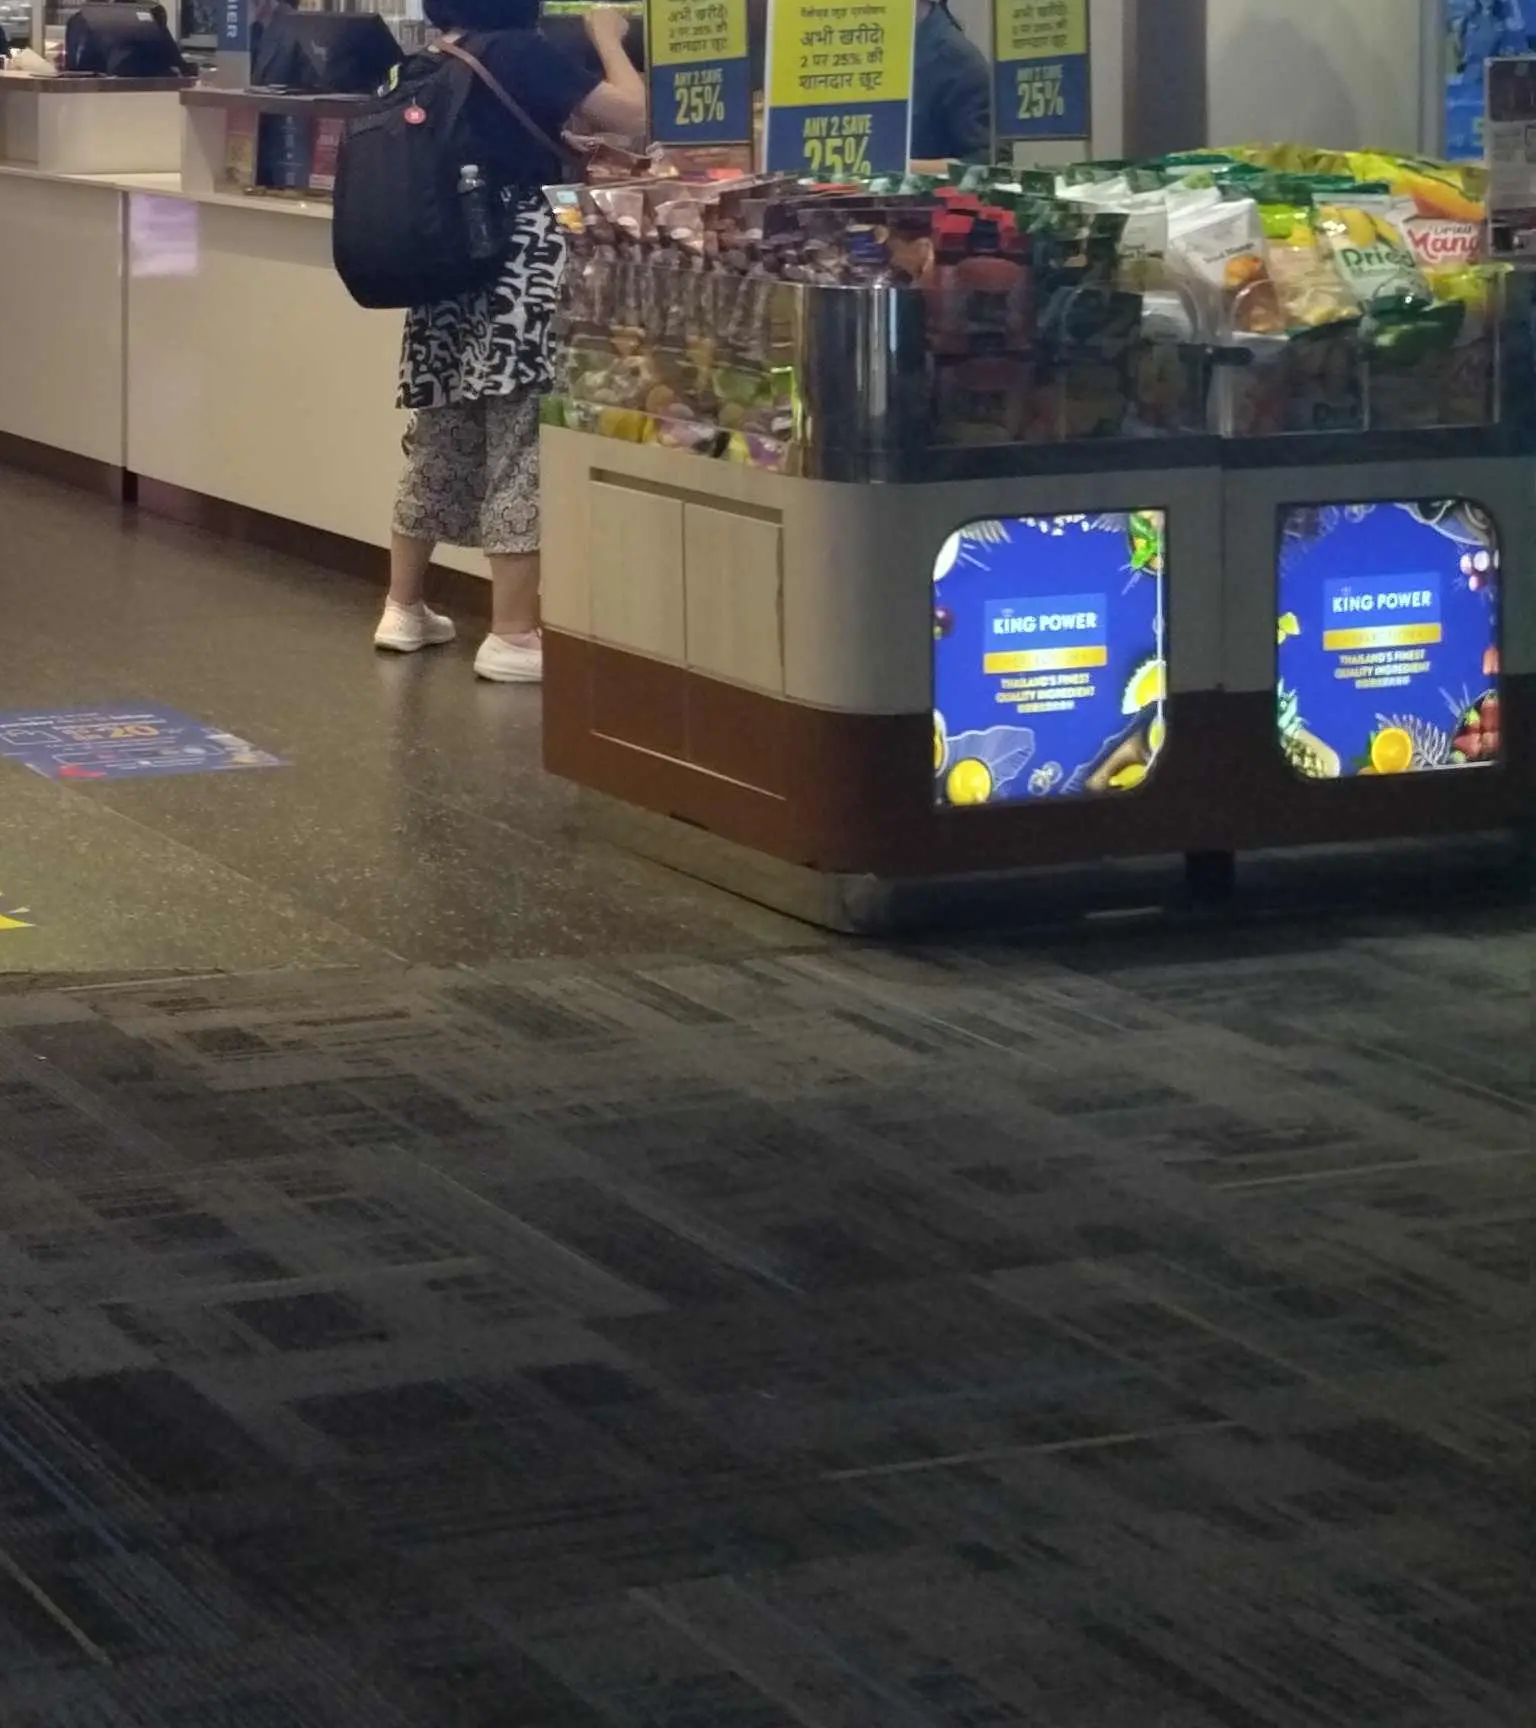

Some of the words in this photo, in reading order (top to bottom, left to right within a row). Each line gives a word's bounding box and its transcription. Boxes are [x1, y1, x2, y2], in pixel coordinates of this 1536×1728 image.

[800, 24, 834, 46] अभी
[800, 55, 808, 68] 2
[812, 53, 828, 66] पर
[832, 53, 863, 67] 25%
[798, 73, 854, 90] शानदार
[675, 85, 725, 125] 25%
[1017, 80, 1065, 119] 25%
[803, 116, 828, 138] ANY
[829, 115, 840, 136] 2
[841, 114, 873, 136] SAVE
[803, 135, 872, 176] 25%
[1332, 594, 1373, 613] KING
[1377, 590, 1432, 610] POWER
[993, 616, 1036, 634] KING
[1039, 611, 1097, 632] POWER
